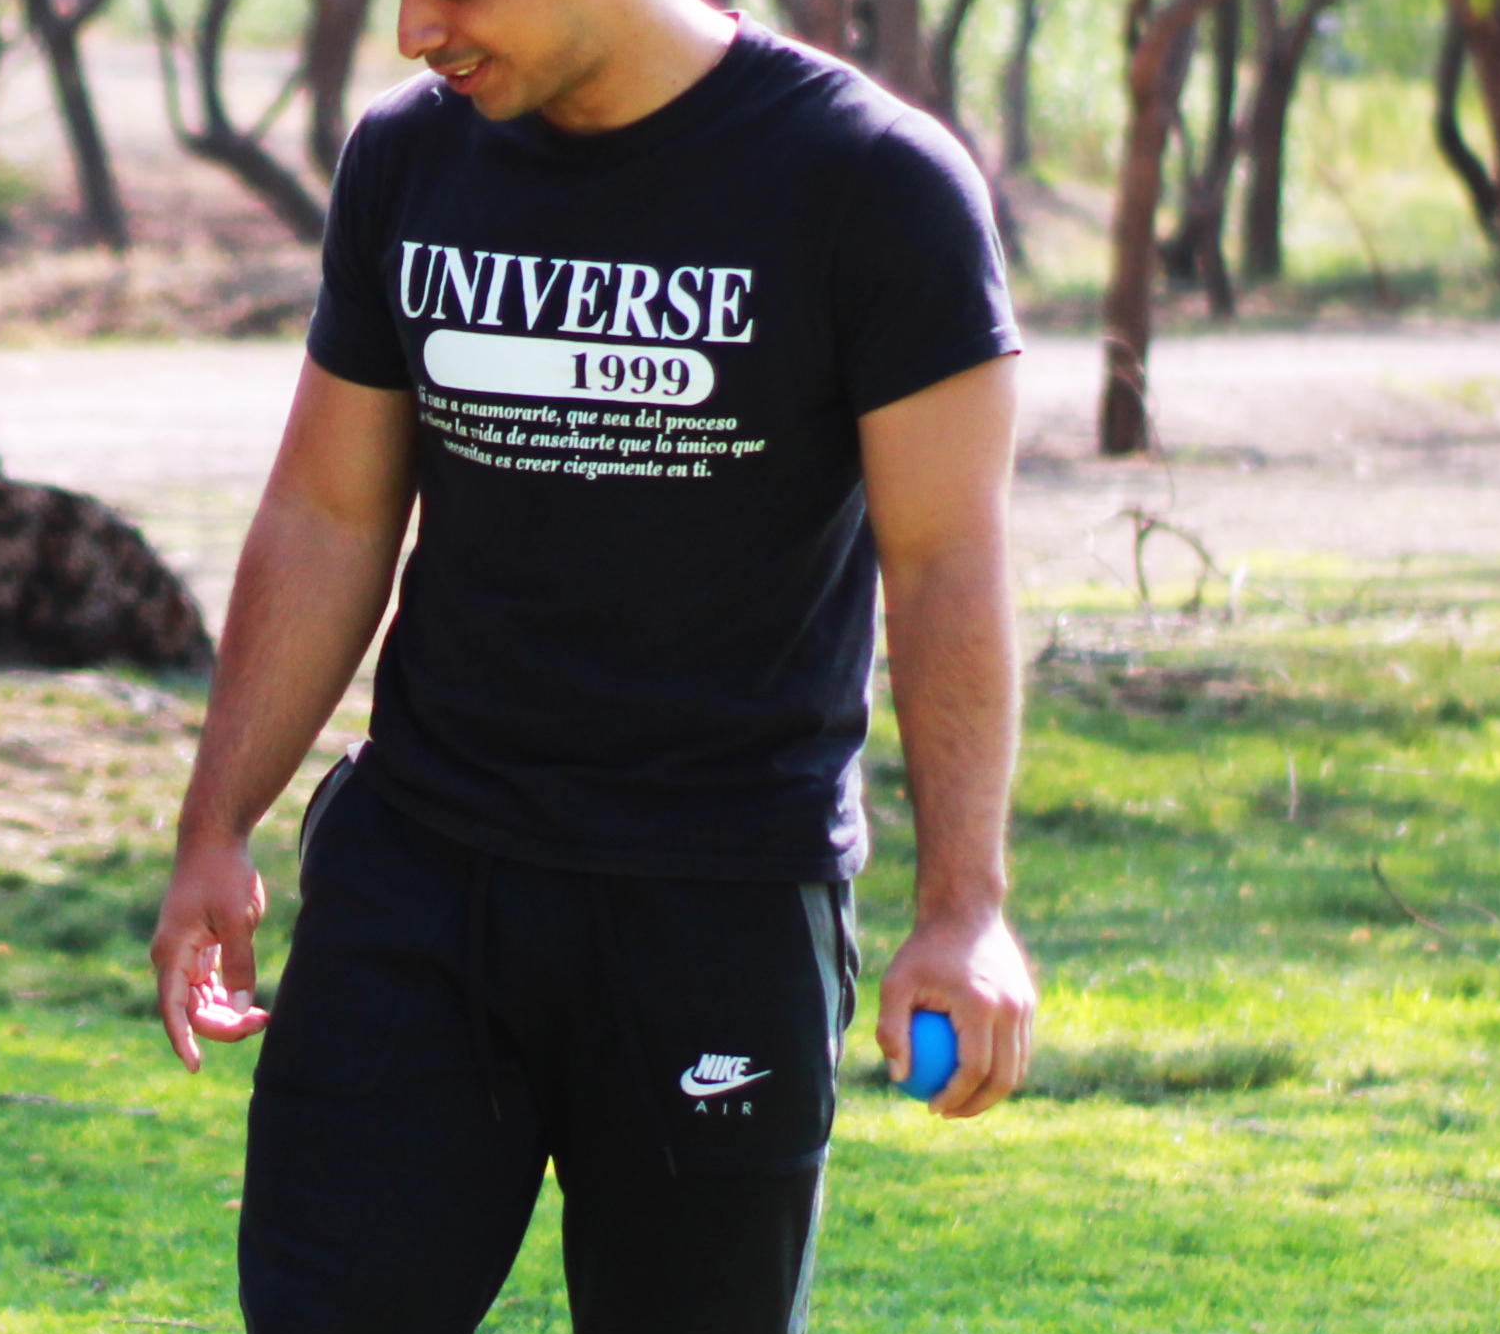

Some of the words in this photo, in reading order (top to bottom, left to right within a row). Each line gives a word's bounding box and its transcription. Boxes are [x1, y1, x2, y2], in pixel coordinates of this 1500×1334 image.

[399, 240, 754, 344] UNIVERSE
[569, 351, 691, 396] 1999
[427, 393, 447, 410] vas
[450, 400, 459, 413] a
[461, 402, 562, 427] enamorarte,
[566, 409, 598, 429] que
[602, 412, 631, 427] sea
[635, 408, 662, 429] del
[665, 415, 738, 435] proceso
[455, 417, 468, 437] la
[470, 422, 503, 444] vida
[506, 425, 527, 446] de
[529, 430, 616, 451] enseñarte
[619, 437, 651, 457] que
[654, 433, 673, 454] lo
[676, 435, 728, 454] único
[731, 438, 766, 458] que
[495, 455, 512, 469] es
[515, 457, 561, 472] creer
[563, 454, 663, 481] ciegamente
[666, 464, 688, 477] en
[692, 458, 712, 477] ti.
[693, 1053, 751, 1082] NIKE
[695, 1100, 752, 1115] AIR
